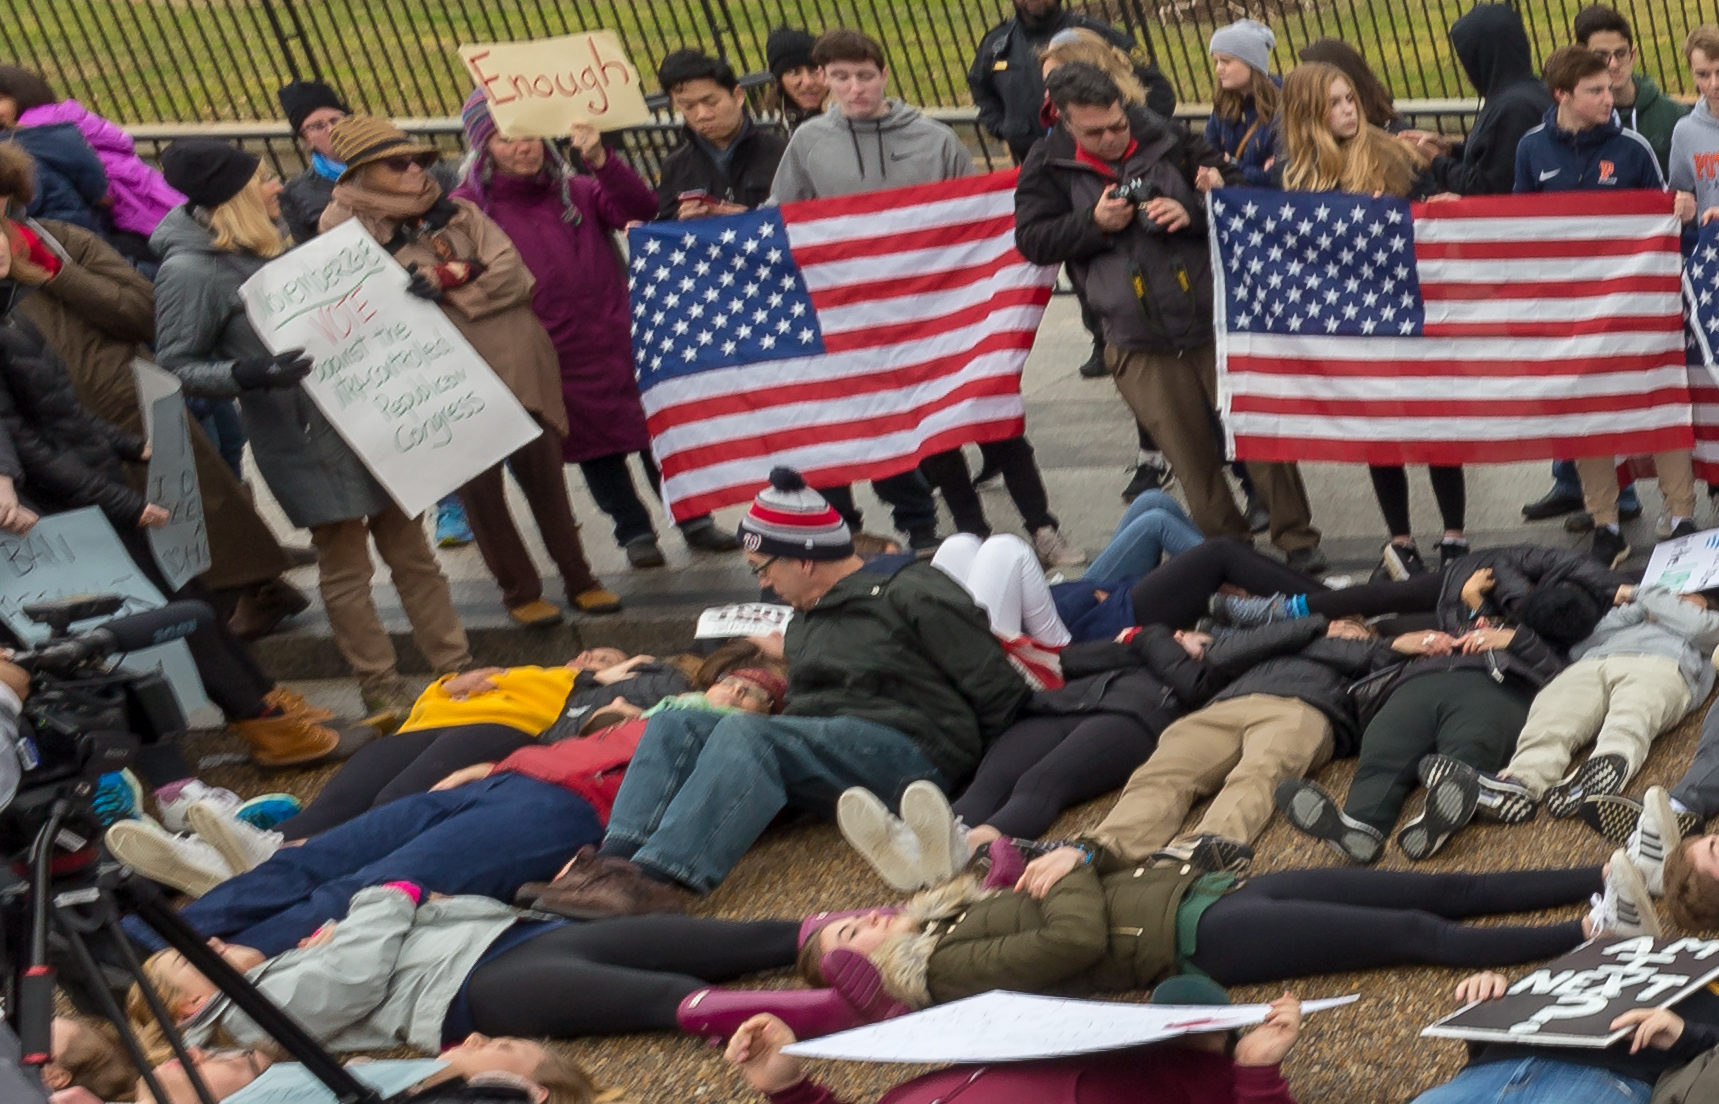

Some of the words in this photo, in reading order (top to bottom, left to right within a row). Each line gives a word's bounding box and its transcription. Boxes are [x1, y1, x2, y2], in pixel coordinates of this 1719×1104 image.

[469, 36, 630, 115] Enough
[308, 285, 377, 345] VOTE
[1507, 965, 1691, 1004] NEXT
